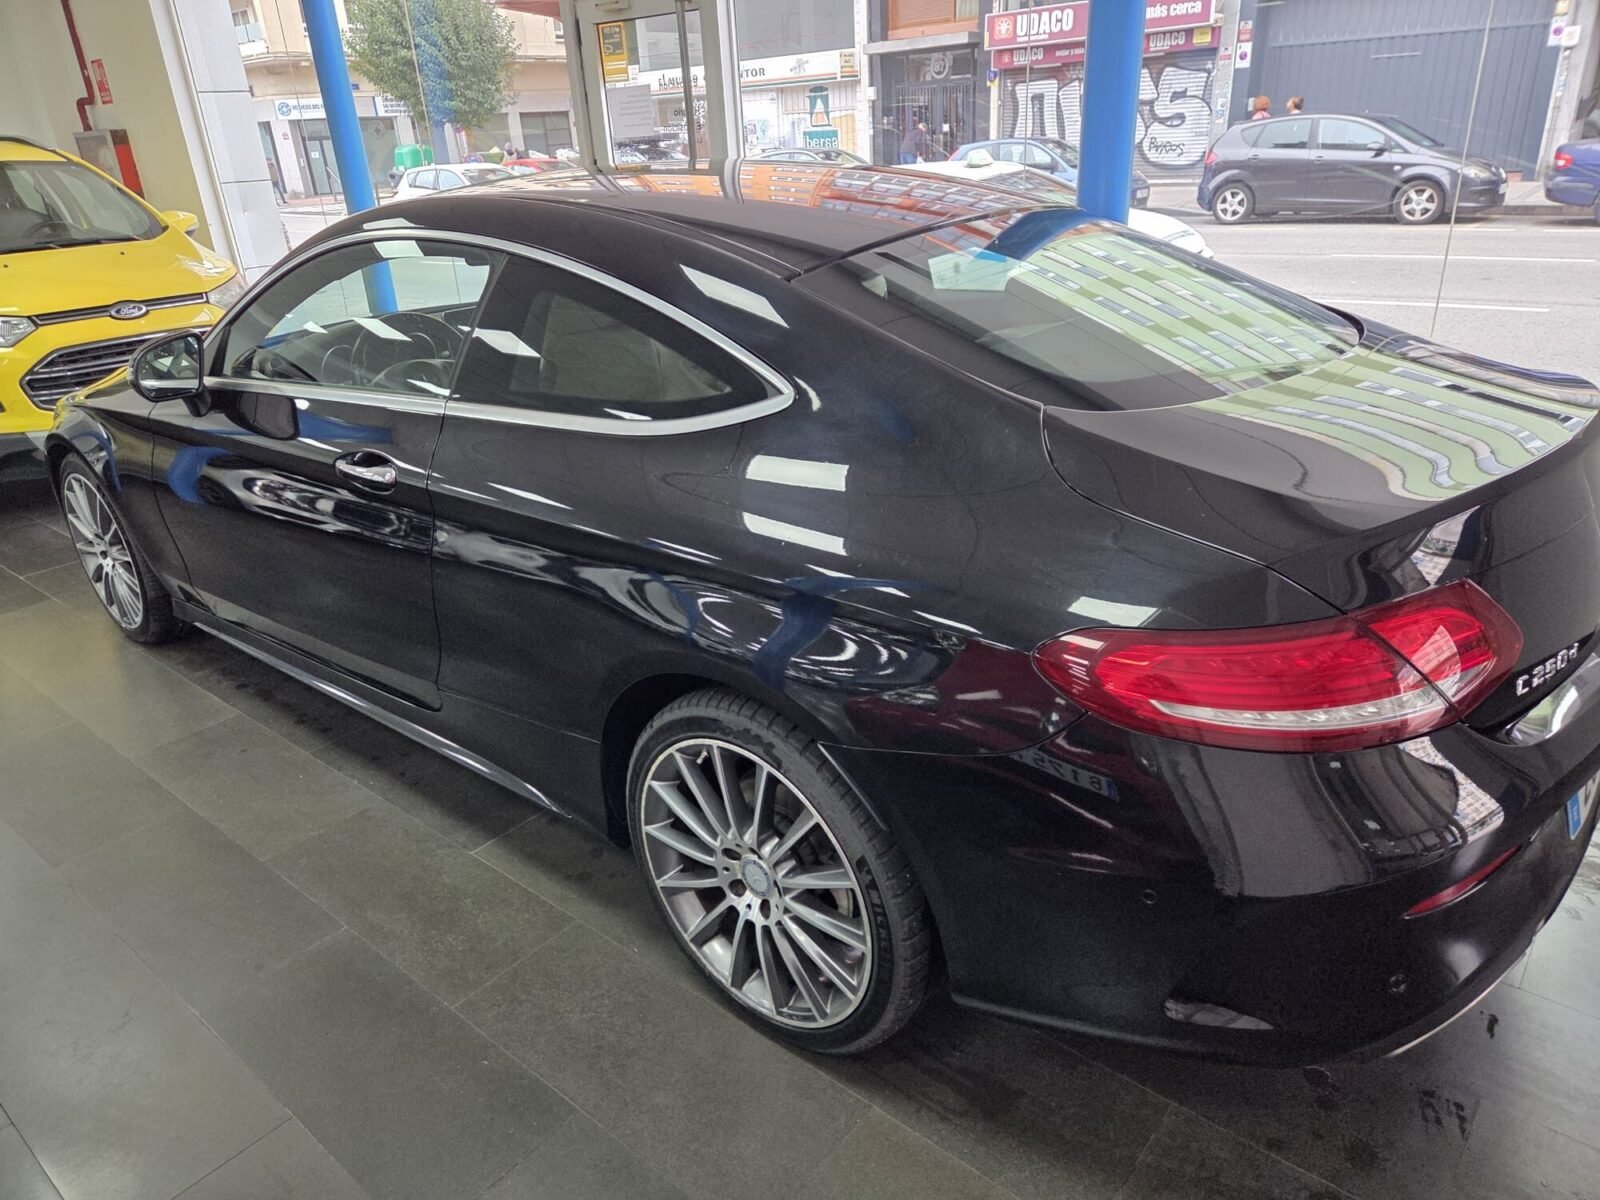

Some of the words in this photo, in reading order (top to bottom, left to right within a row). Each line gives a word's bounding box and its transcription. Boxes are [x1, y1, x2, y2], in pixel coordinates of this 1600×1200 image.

[1169, 1, 1202, 16] cerca
[1016, 8, 1074, 36] UDACO
[1149, 31, 1186, 47] UDACO
[1013, 47, 1044, 61] UDACO
[120, 305, 138, 315] Ford
[1516, 674, 1529, 697] C
[1532, 649, 1568, 688] 250
